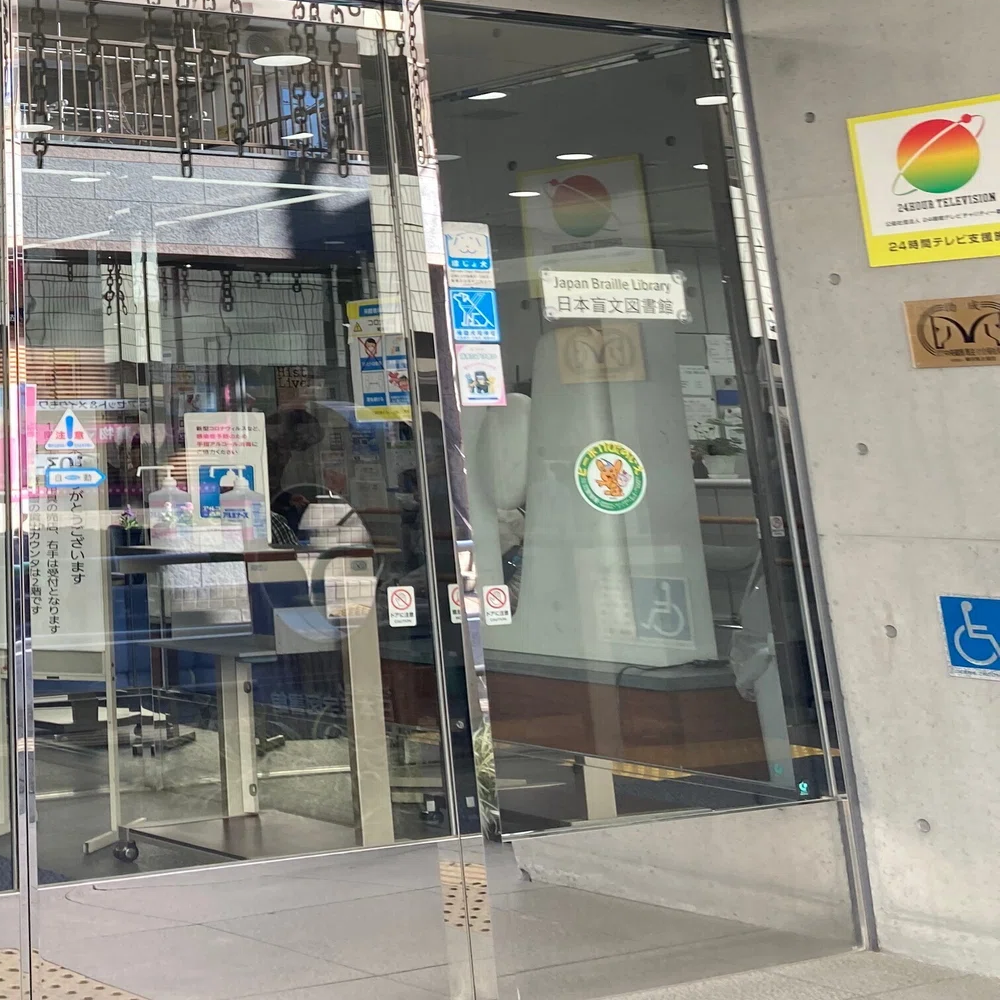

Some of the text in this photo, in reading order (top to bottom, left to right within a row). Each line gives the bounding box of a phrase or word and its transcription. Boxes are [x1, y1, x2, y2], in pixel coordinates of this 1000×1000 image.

[897, 192, 997, 213] 24HOUR TELEVISION
[553, 276, 671, 294] Japan Braille Library
[69, 485, 86, 585] がとうございます
